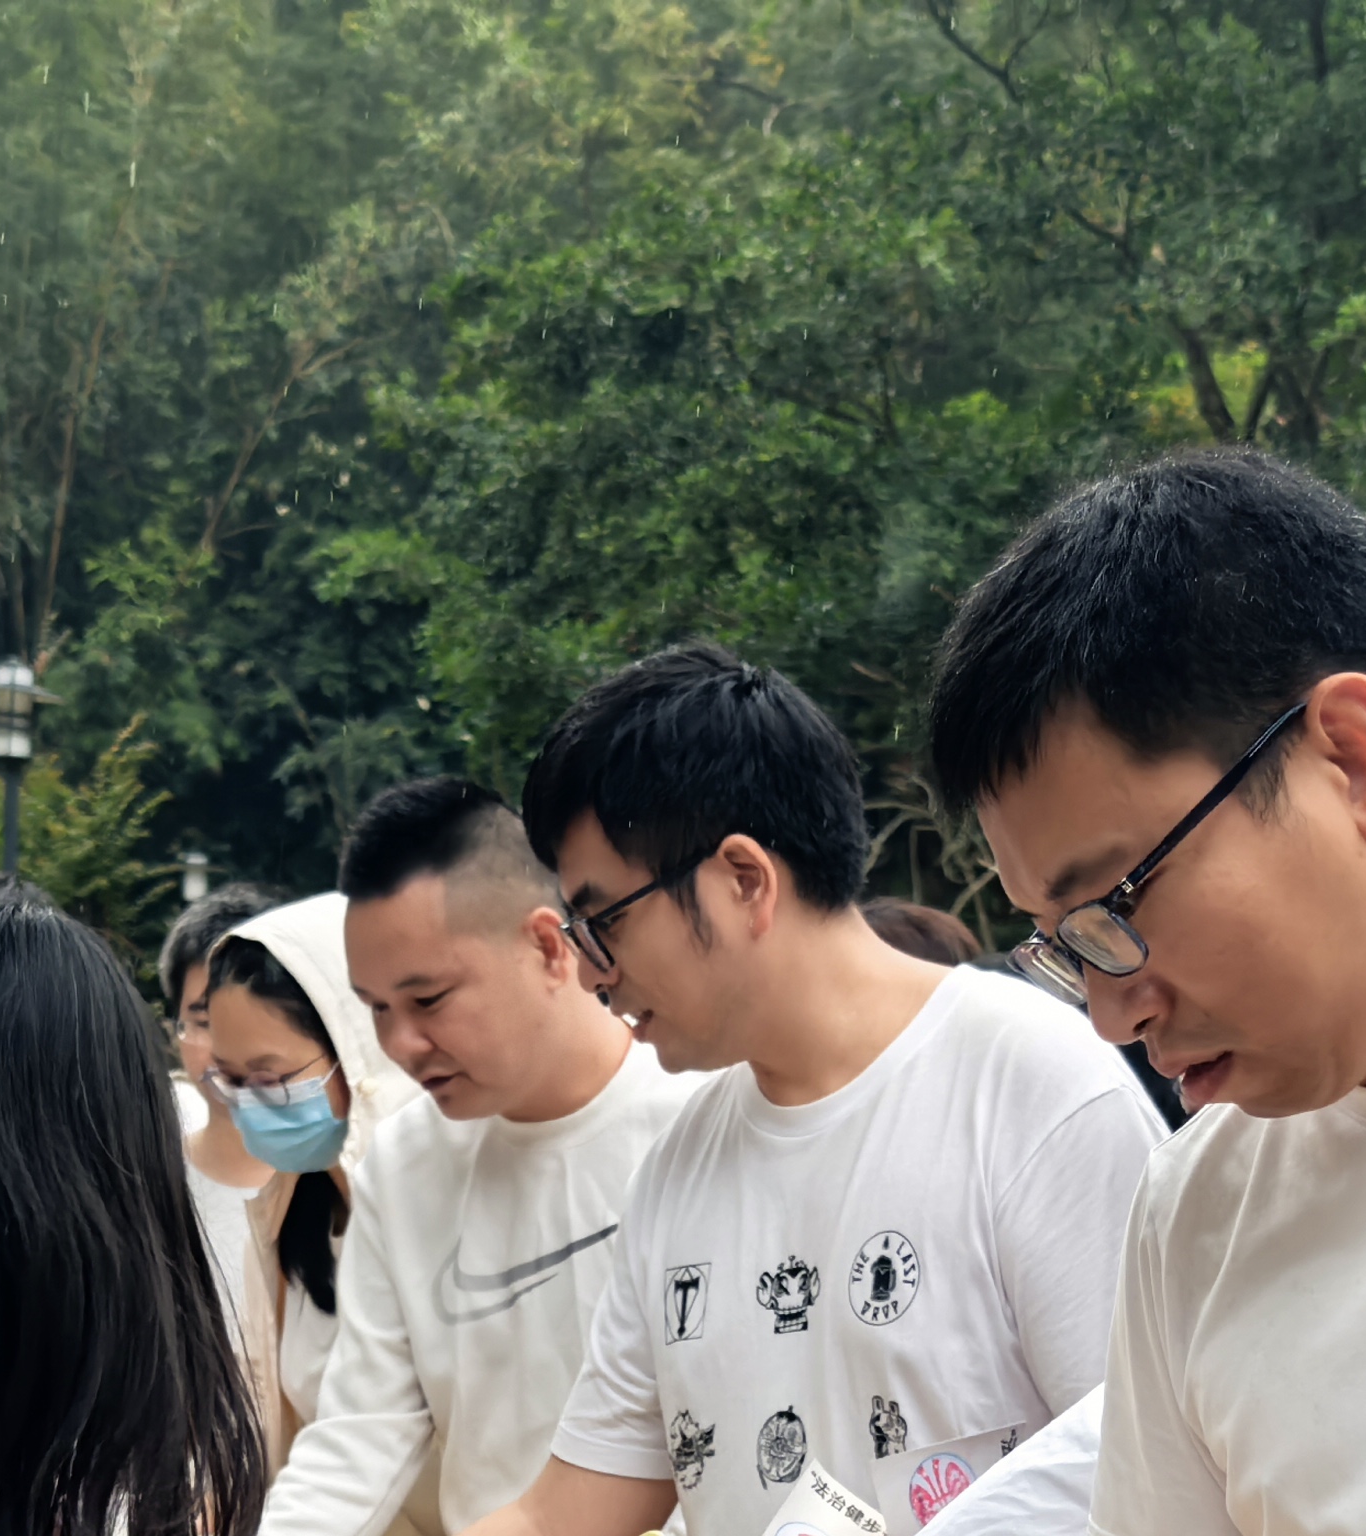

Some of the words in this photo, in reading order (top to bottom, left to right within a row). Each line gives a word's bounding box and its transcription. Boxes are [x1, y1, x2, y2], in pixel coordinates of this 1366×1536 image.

[852, 1252, 870, 1284] THE
[896, 1241, 916, 1288] LAST
[860, 1300, 898, 1321] DROP
